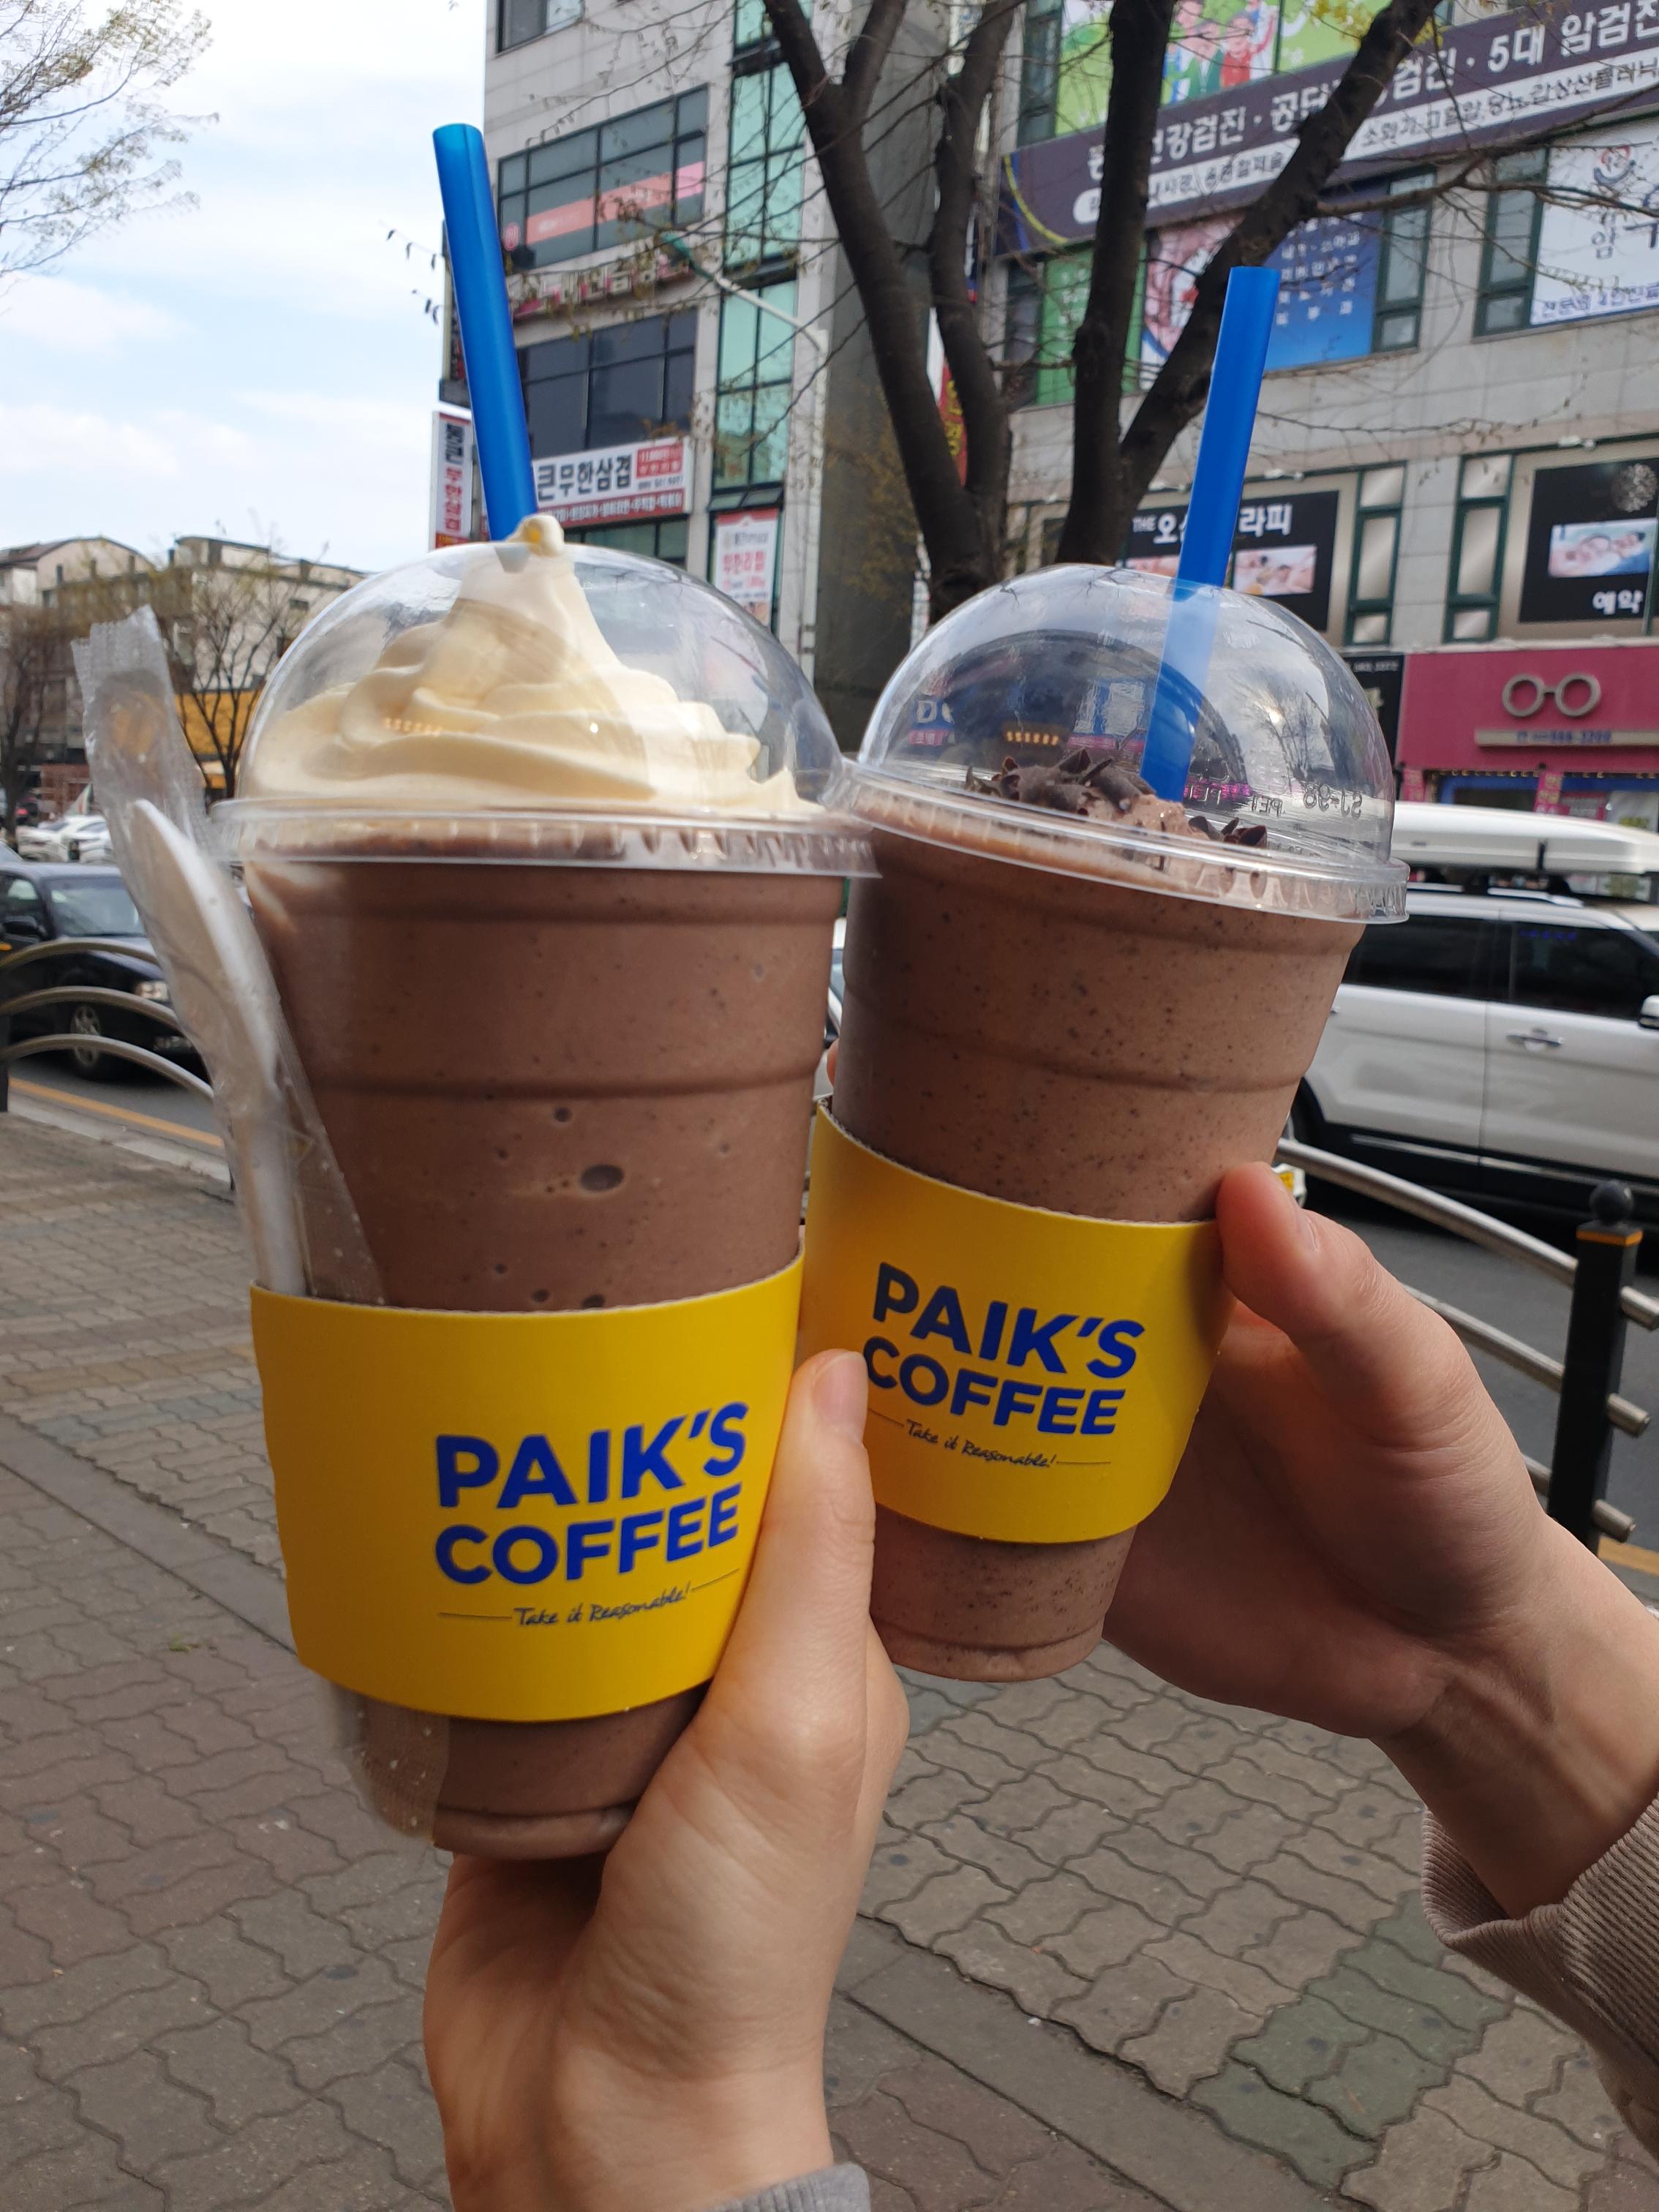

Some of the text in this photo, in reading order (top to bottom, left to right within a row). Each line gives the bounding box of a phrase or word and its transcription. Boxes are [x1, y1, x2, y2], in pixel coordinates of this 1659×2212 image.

[1487, 24, 1546, 72] 5대
[1132, 515, 1156, 533] THE
[1592, 590, 1644, 615] 예약
[873, 1261, 1146, 1379] PAIK'S
[863, 1335, 1126, 1434] COFFEE
[436, 1401, 750, 1510] PAIK'S
[906, 1418, 1058, 1469] Take it Reasonable!
[434, 1481, 742, 1585] COFFEE
[514, 1580, 692, 1626] Take it Reasonable!
